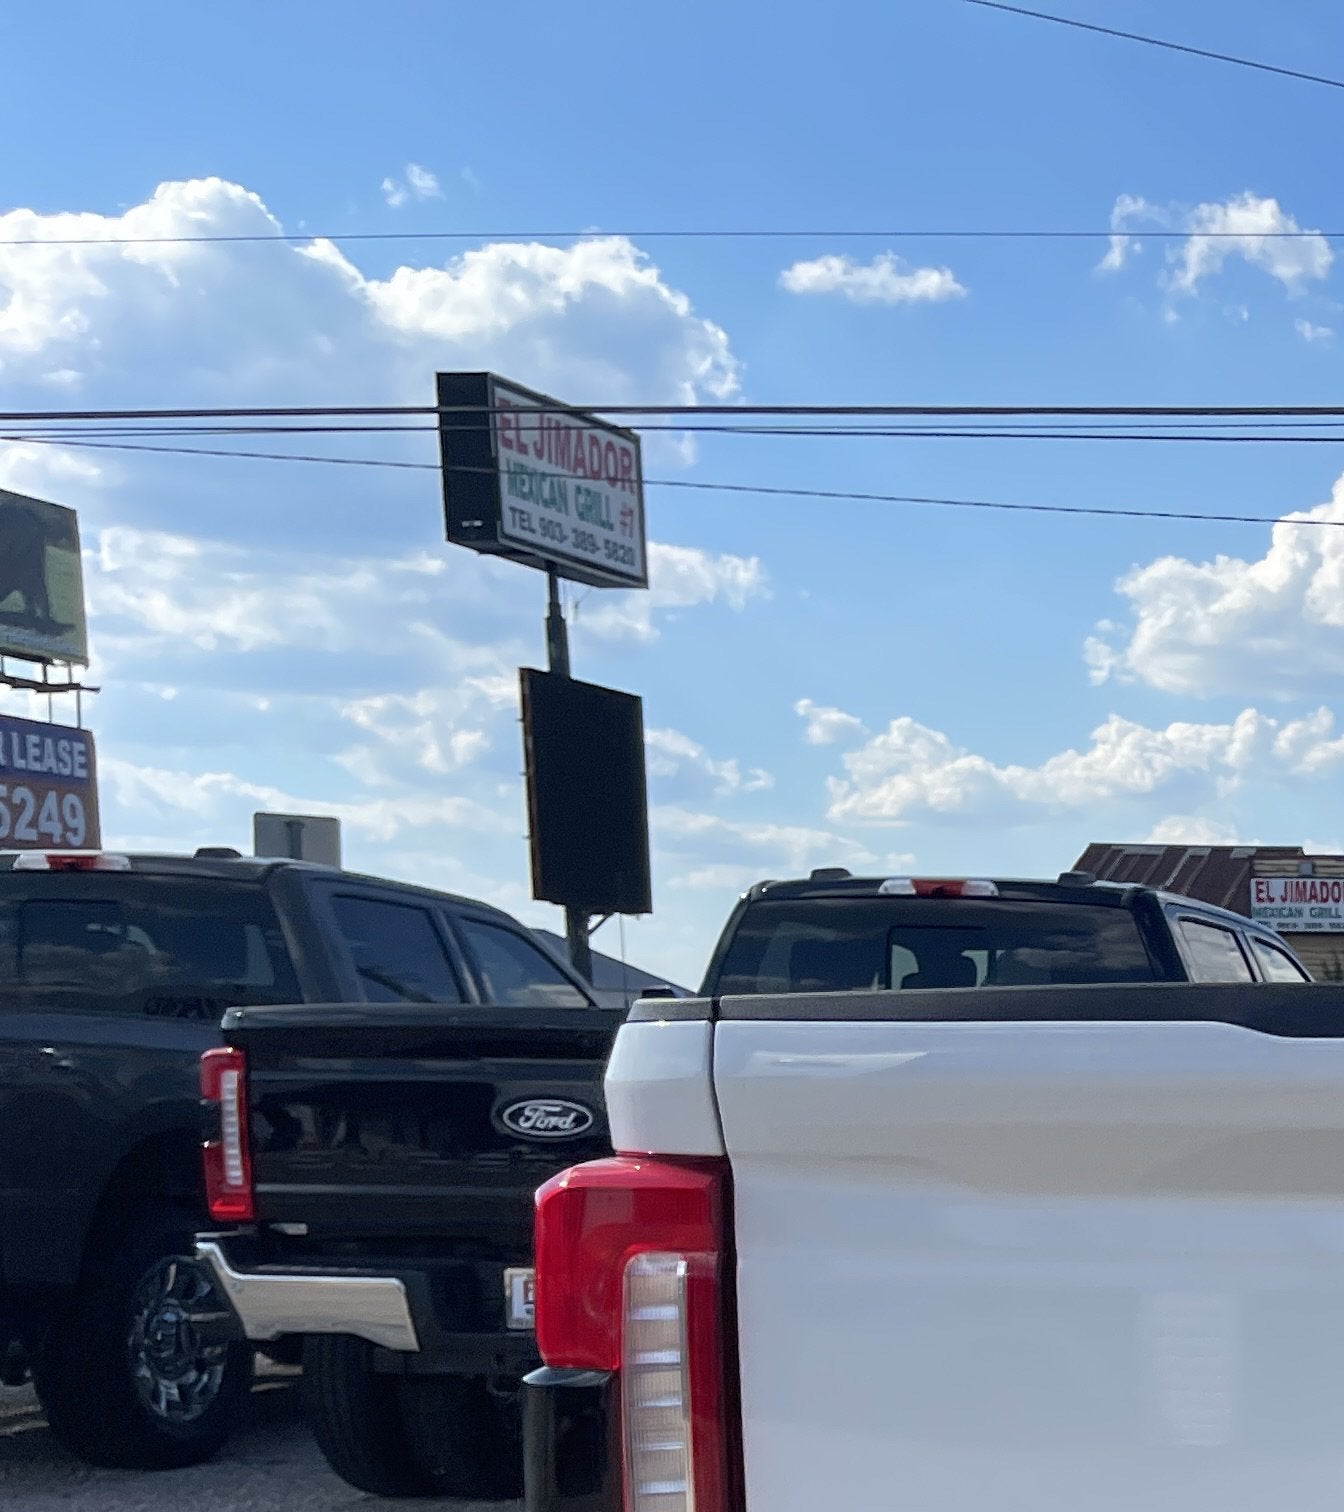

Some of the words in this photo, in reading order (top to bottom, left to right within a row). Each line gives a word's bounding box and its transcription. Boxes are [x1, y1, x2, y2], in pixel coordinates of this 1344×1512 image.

[497, 398, 528, 455] EL
[533, 412, 635, 496] JIMADOR
[506, 458, 569, 516] MEXICAN
[574, 484, 614, 532] GRILL
[508, 506, 536, 534] TEL
[11, 731, 87, 778] LEASE
[1255, 880, 1275, 903] EL
[1252, 906, 1304, 919] MEXICAN
[1309, 906, 1342, 919] GRILL
[518, 1104, 578, 1130] Ford
